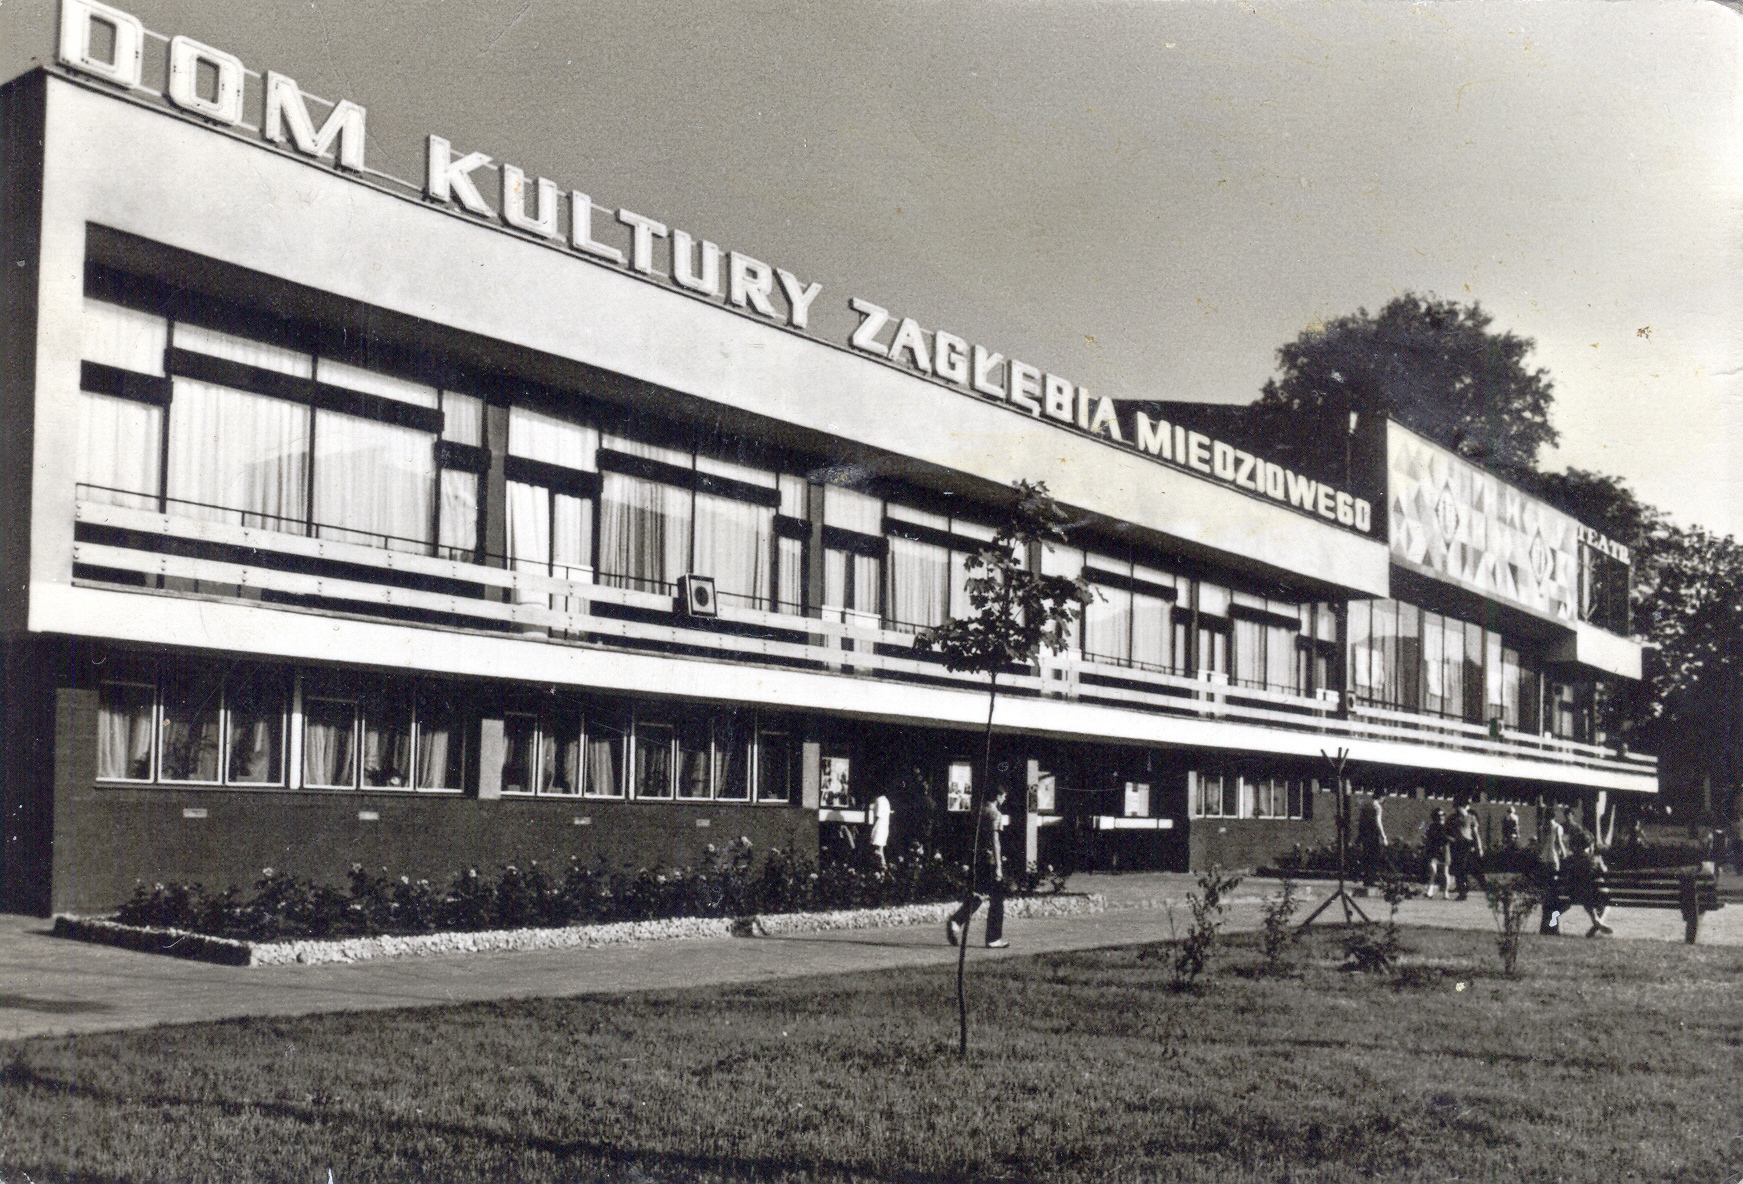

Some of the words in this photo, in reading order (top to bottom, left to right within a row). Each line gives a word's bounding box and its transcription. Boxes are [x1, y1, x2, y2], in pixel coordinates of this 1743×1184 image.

[58, 0, 366, 173] DOM
[427, 133, 823, 329] KULTURY
[850, 297, 1122, 442] ZAGŁĘBIA
[1136, 411, 1371, 533] MIEDZIOWEGO
